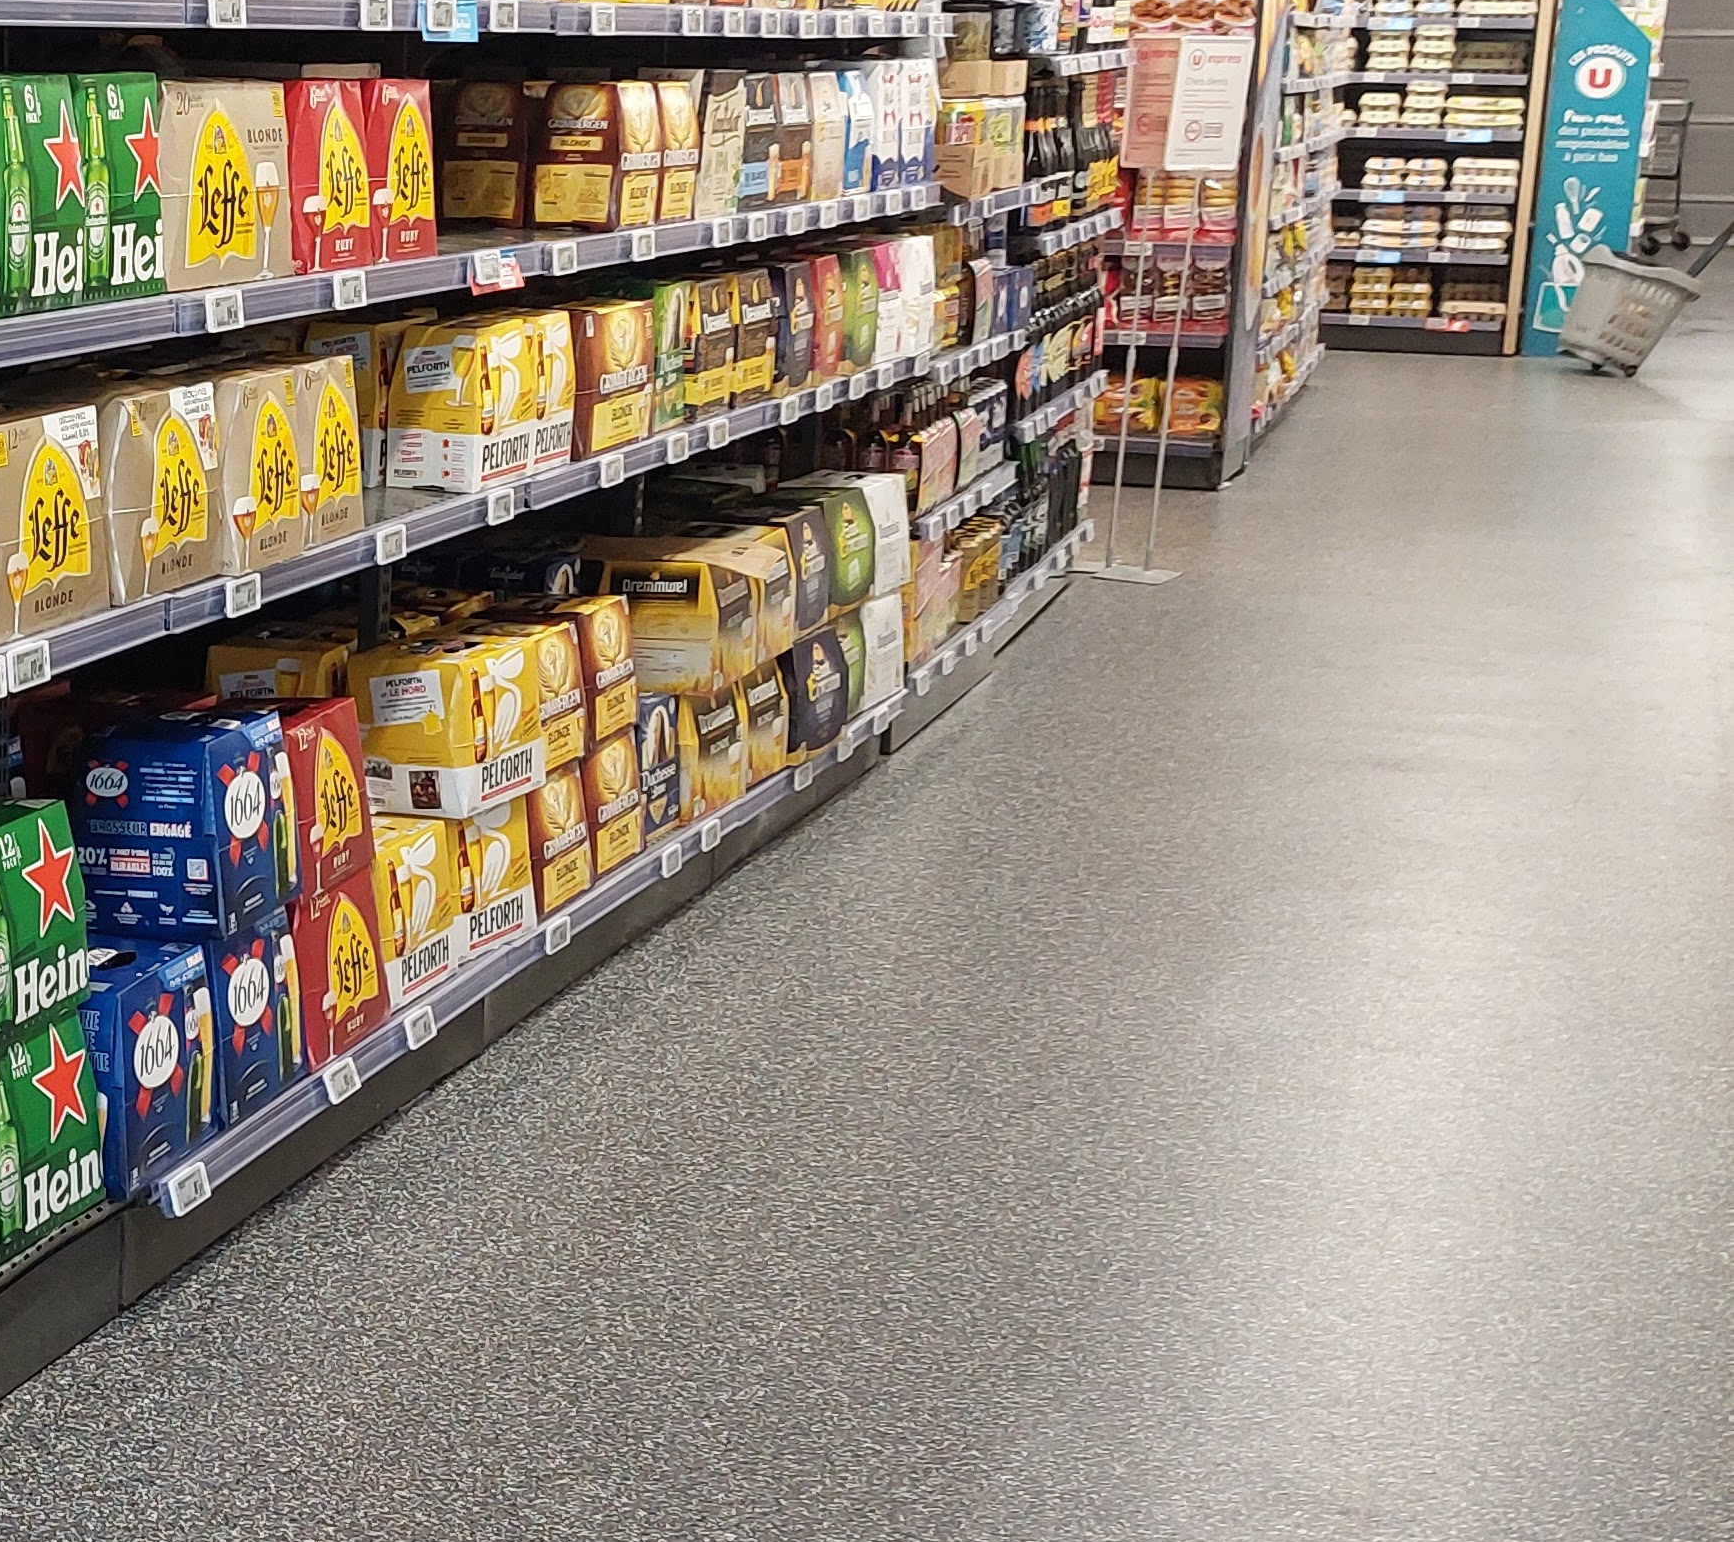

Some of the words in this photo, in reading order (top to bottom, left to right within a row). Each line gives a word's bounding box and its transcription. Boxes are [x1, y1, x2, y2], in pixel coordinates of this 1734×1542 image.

[1588, 67, 1613, 89] U
[246, 126, 283, 147] BLONDE
[197, 160, 251, 250] Leffe
[482, 432, 530, 473] PELFORTH
[159, 458, 201, 538] Leffe
[29, 485, 81, 574] Leffe
[260, 529, 288, 551] BLONDE
[161, 552, 194, 576] BLONDE
[34, 588, 75, 616] BLONDE
[89, 772, 125, 791] 1664
[481, 747, 534, 794] PELFORTH
[229, 780, 262, 829] 1664
[470, 898, 524, 943] PELFORTH
[400, 935, 450, 986] PELFORTH
[228, 968, 269, 1012] 1664
[136, 1034, 177, 1078] 1664
